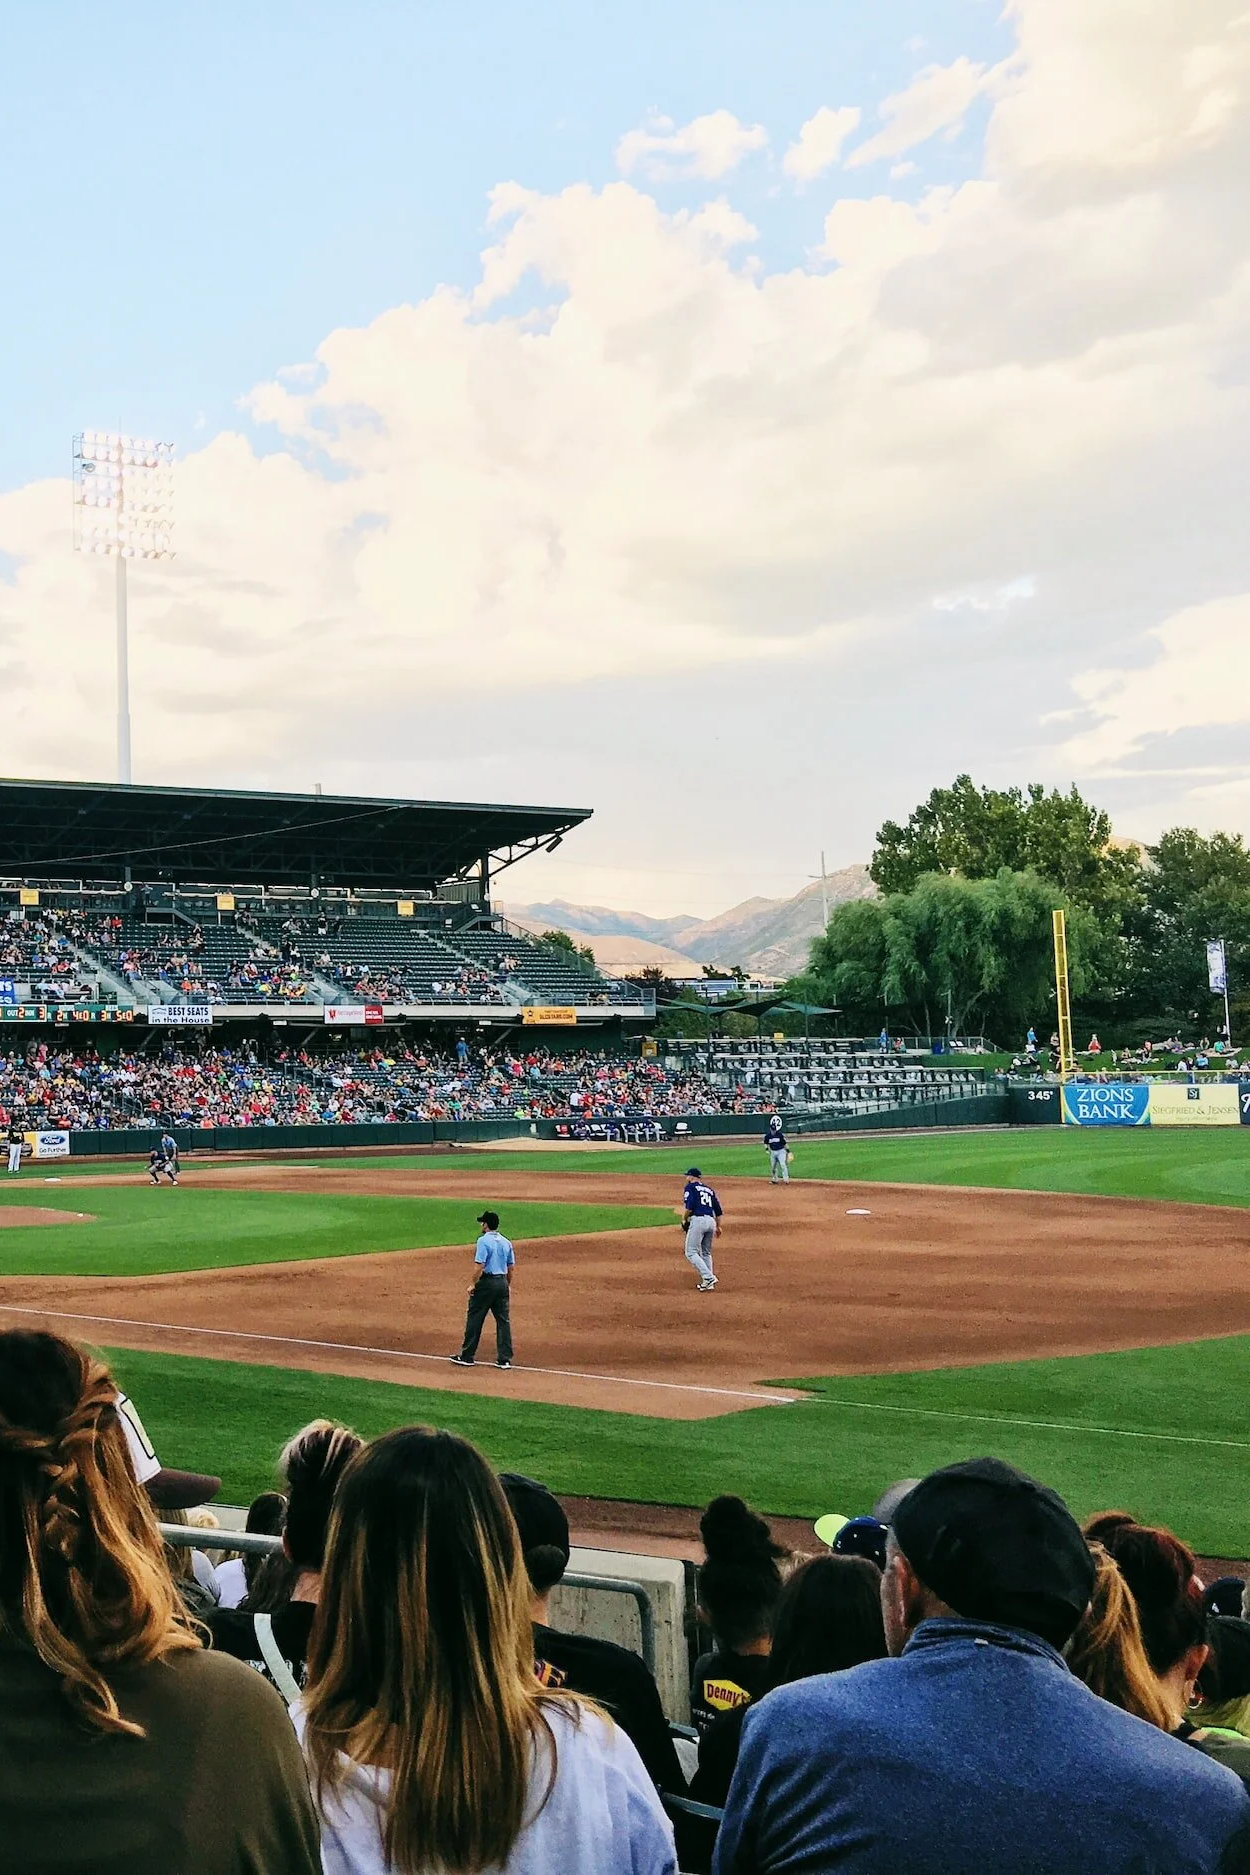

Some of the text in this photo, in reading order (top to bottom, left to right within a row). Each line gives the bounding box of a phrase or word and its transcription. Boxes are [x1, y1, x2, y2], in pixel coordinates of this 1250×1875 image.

[18, 1007, 24, 1018] 2
[39, 1007, 45, 1018] 3
[56, 1010, 62, 1021] 2
[83, 1010, 89, 1021] 0
[101, 1010, 106, 1021] 3
[126, 1010, 132, 1021] 0
[168, 1007, 208, 1016] BEST SEATS
[1076, 1088, 1134, 1102] ZIONS
[1078, 1104, 1138, 1118] BANK
[700, 1191, 712, 1207] 24
